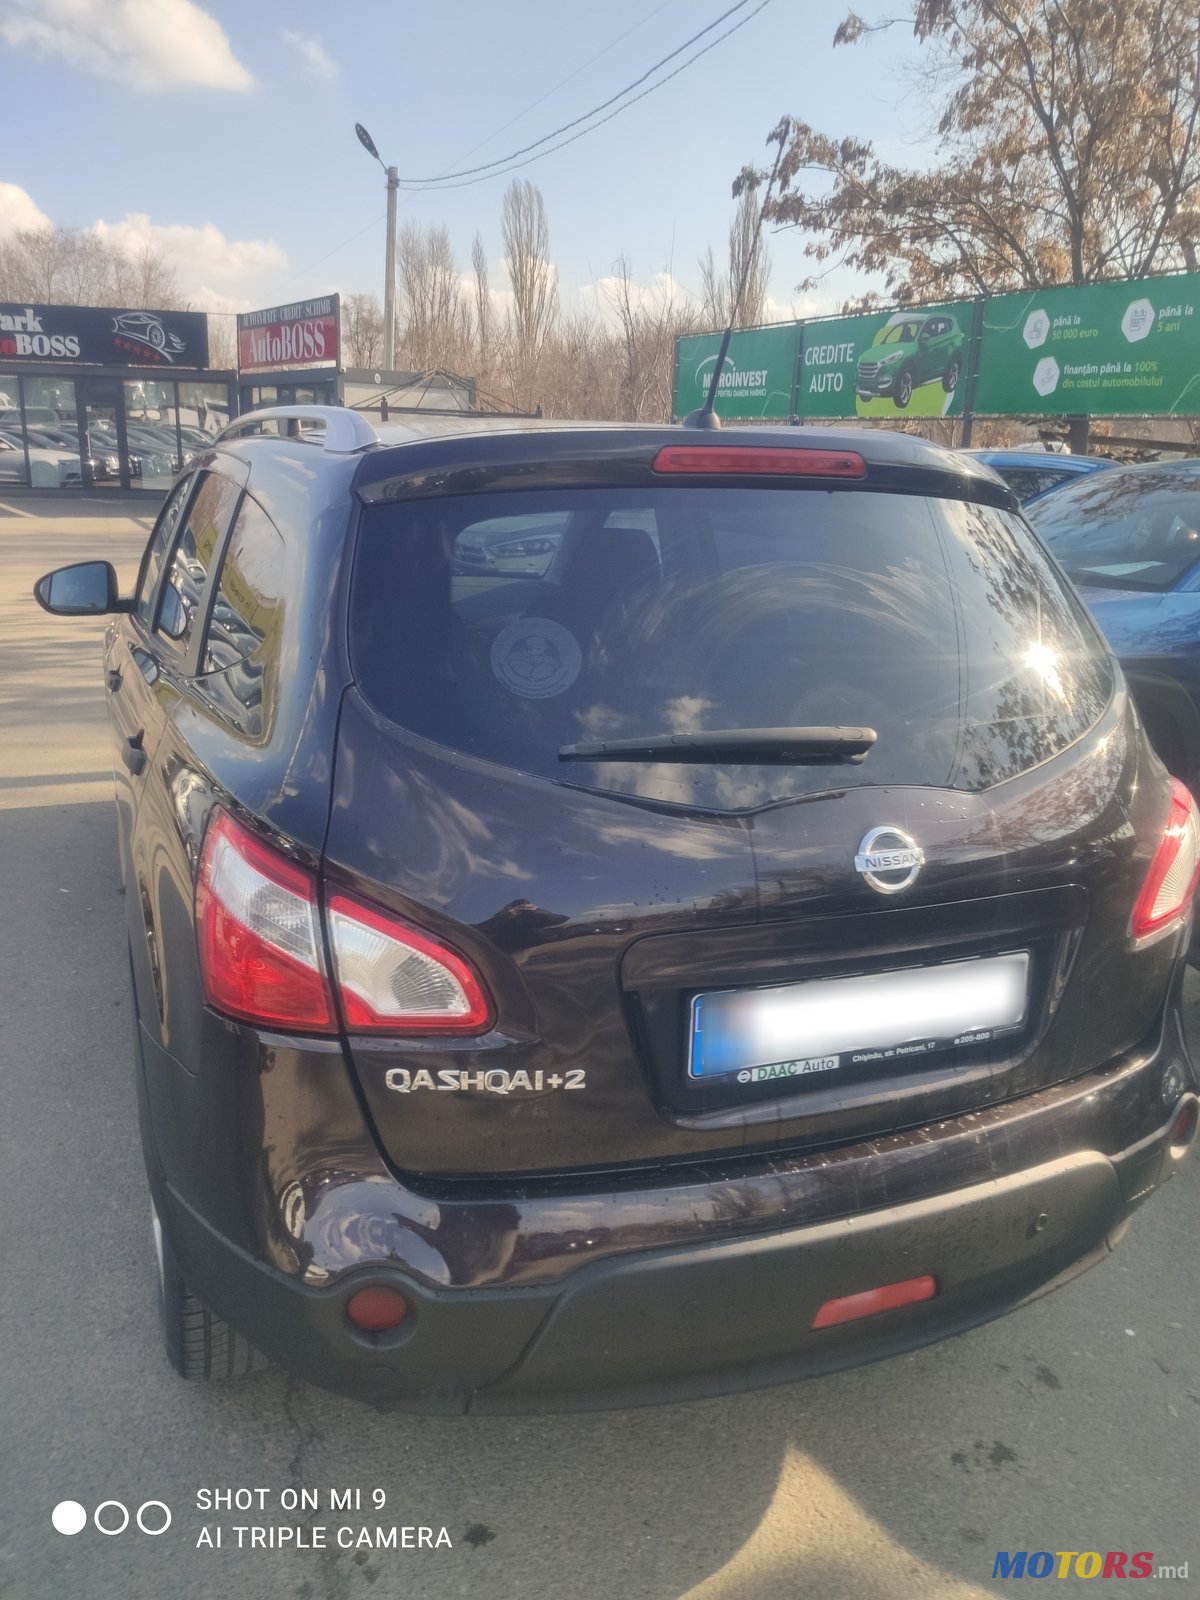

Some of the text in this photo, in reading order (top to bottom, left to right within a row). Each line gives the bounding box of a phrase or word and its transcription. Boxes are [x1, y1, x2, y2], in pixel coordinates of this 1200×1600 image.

[1159, 304, 1194, 320] până la
[0, 308, 44, 332] ark
[1053, 315, 1081, 328] până la
[1157, 321, 1180, 332] 5 ani
[1080, 328, 1098, 338] euro
[249, 320, 325, 362] AutoBOSS
[805, 343, 855, 366] CREDITE
[1100, 362, 1120, 375] până
[1124, 362, 1131, 372] la
[1136, 361, 1158, 372] 100%
[809, 372, 843, 393] AUTO
[1062, 376, 1163, 388] din costul automobilului
[865, 853, 919, 868] NISSAN
[927, 1041, 936, 1049] 17
[757, 1059, 834, 1080] DAAC Auto
[385, 1068, 586, 1094] QASHQAI+2
